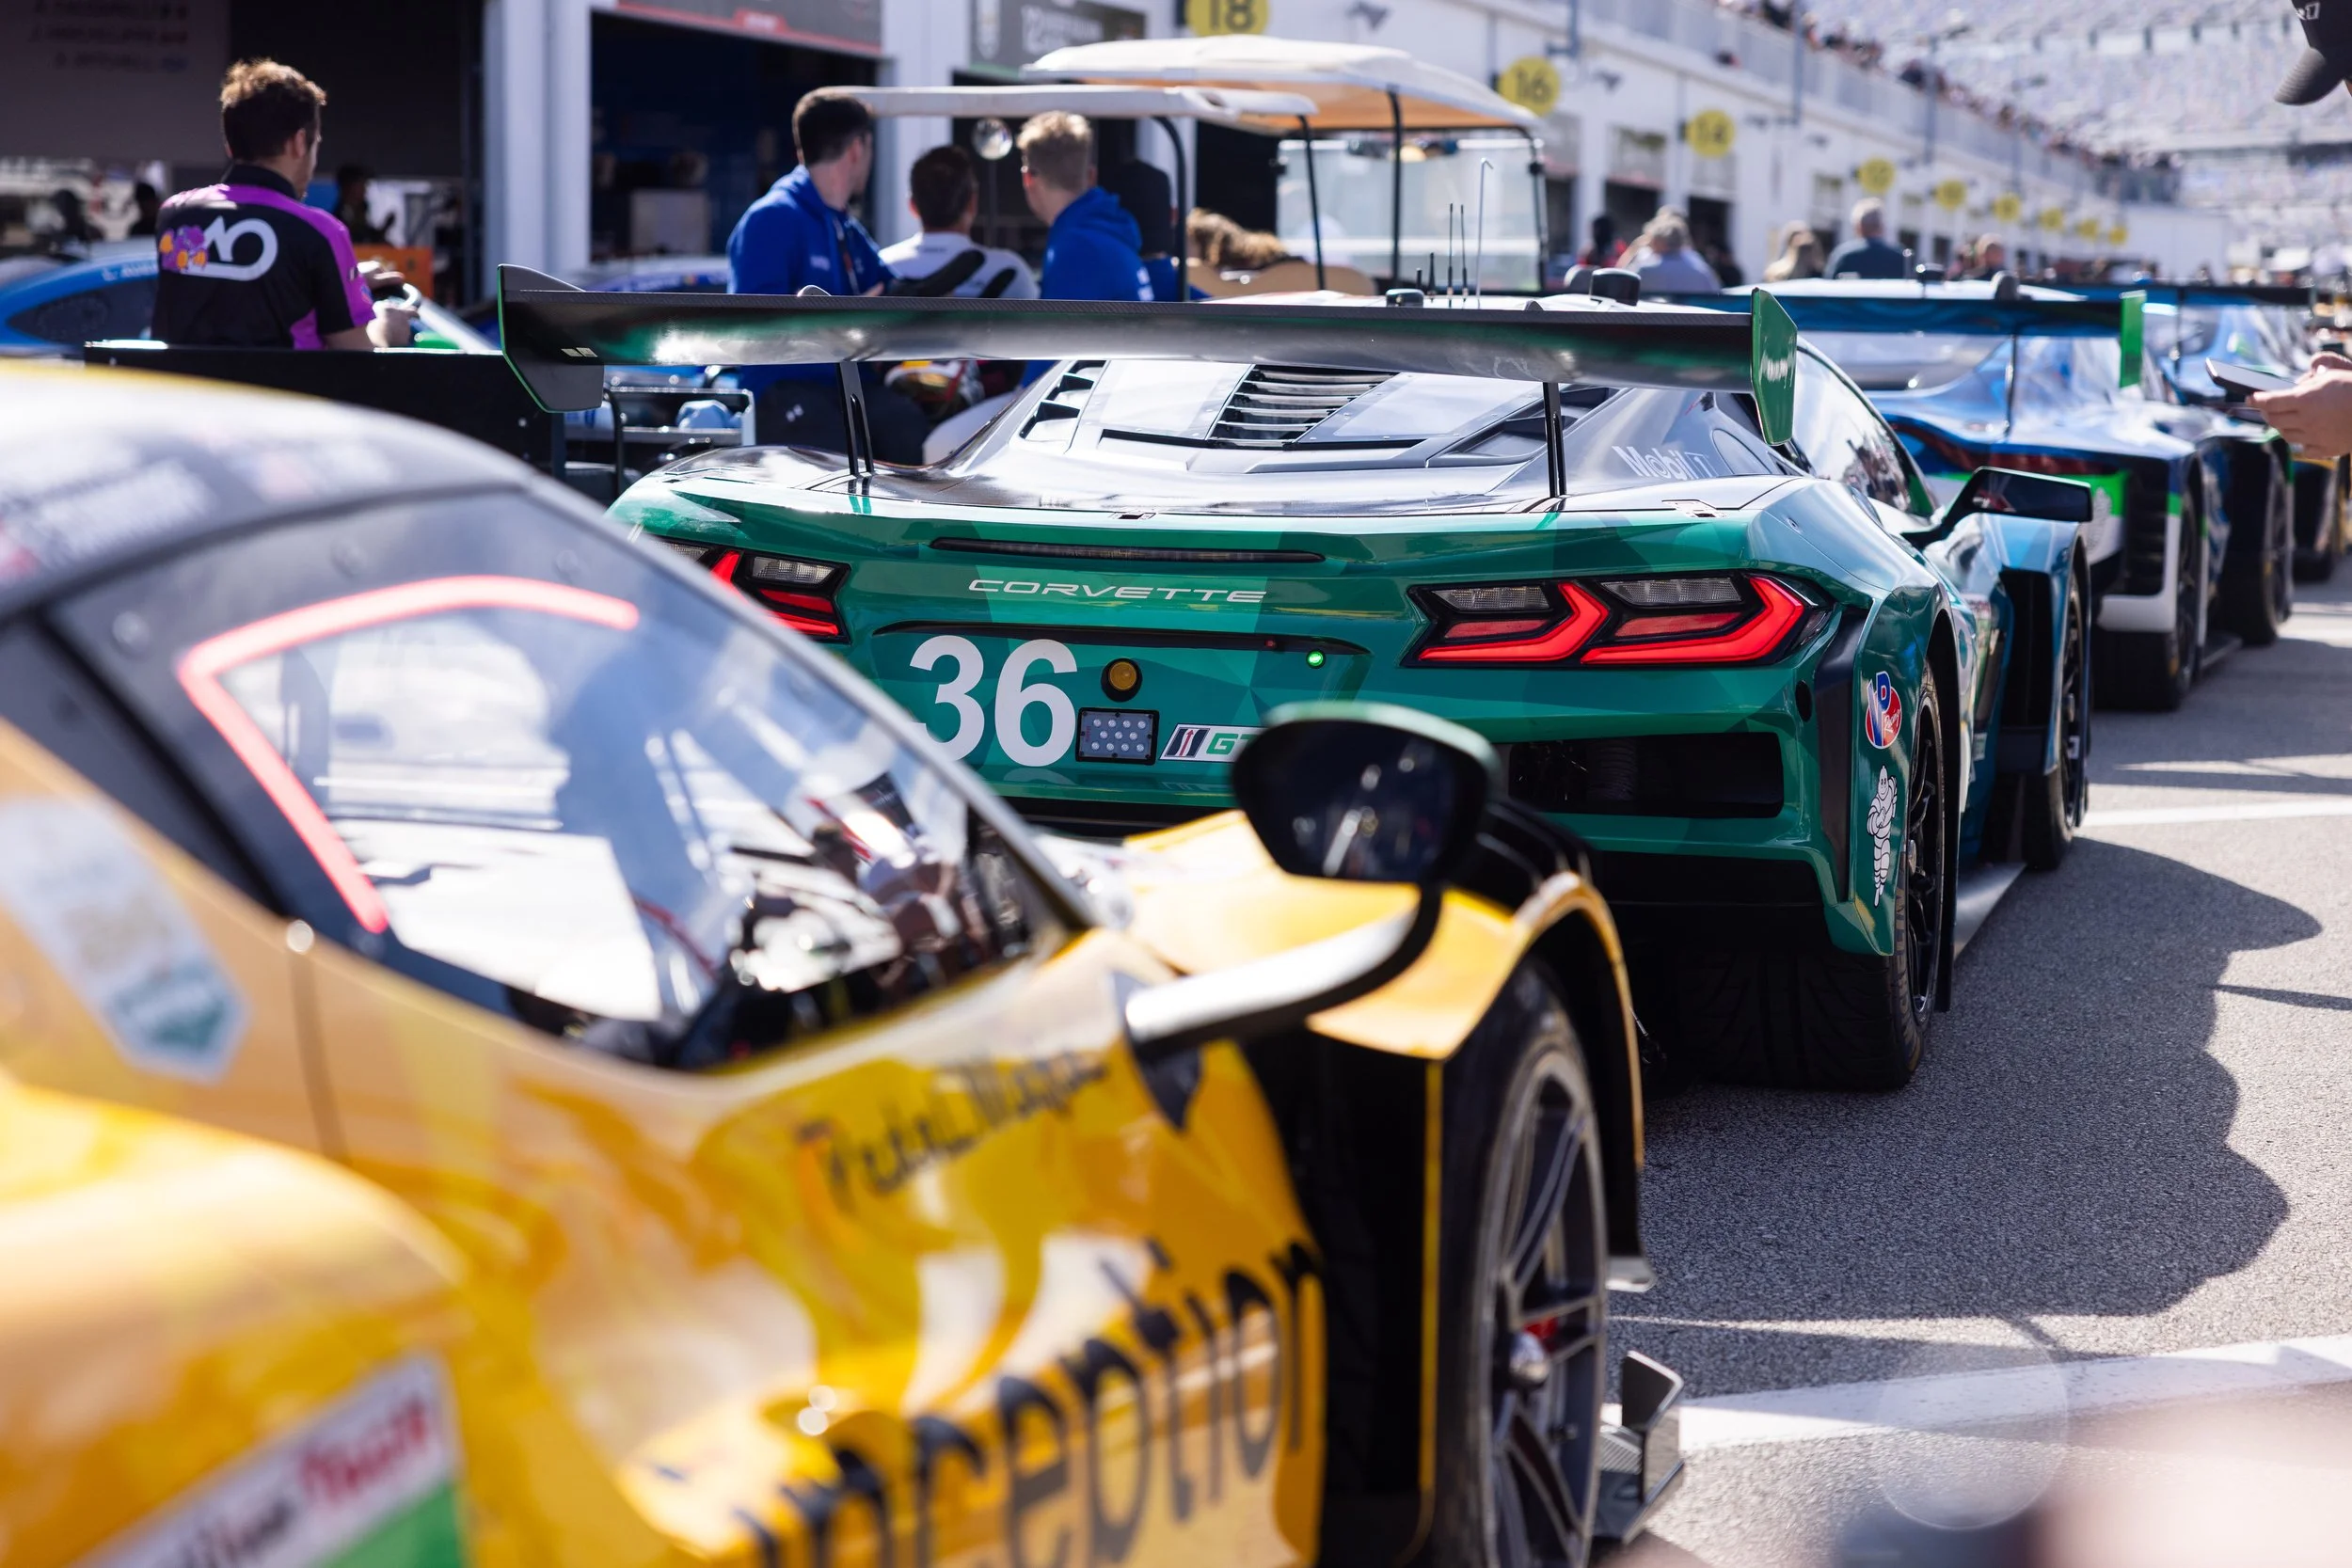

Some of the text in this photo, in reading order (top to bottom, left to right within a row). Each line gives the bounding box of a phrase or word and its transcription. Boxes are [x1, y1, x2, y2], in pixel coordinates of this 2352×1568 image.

[1208, 0, 1257, 34] 18
[1612, 445, 1699, 481] Mobil
[968, 578, 1267, 603] CORVETTE
[909, 635, 1078, 767] 36
